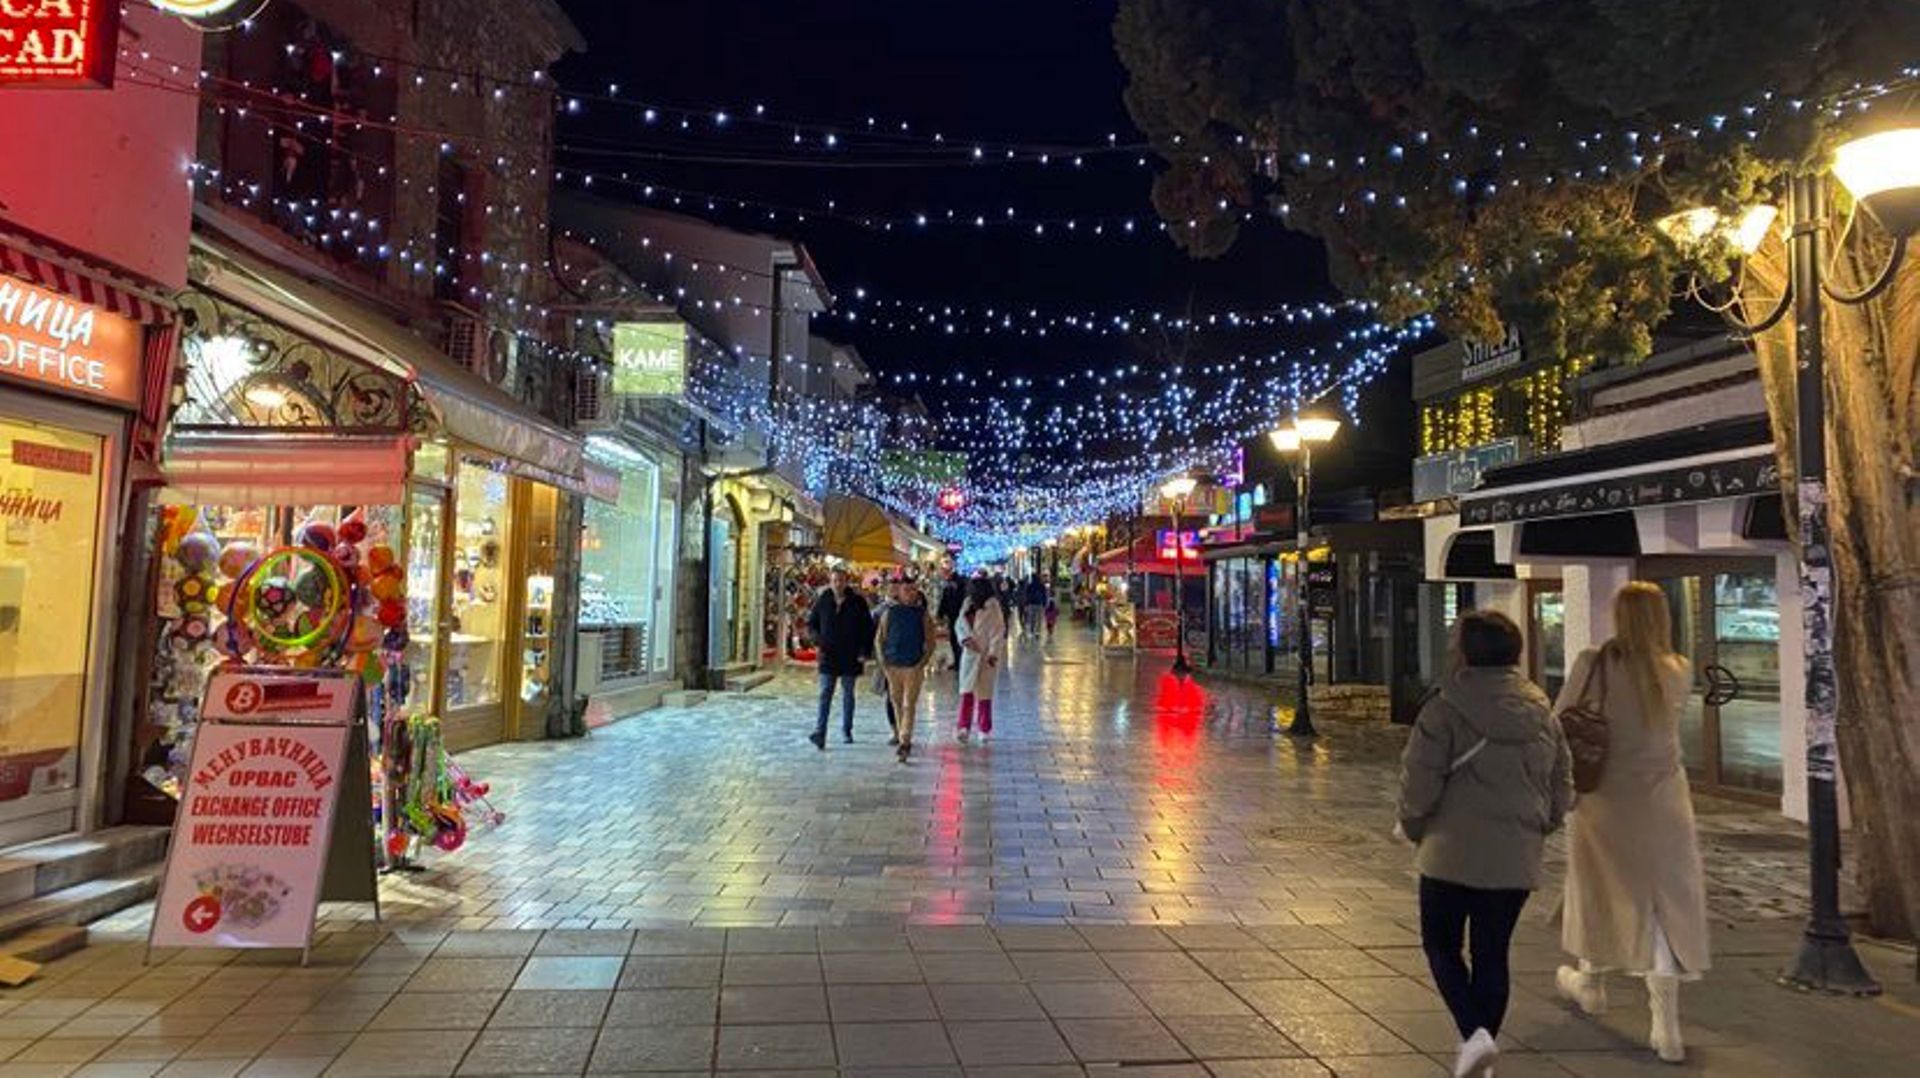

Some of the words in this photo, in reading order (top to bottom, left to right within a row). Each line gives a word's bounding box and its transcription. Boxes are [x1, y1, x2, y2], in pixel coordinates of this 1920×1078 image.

[0, 334, 105, 390] OFFICE
[620, 348, 679, 371] KAME
[194, 737, 332, 790] МЕНУВАЧНИЦА
[191, 796, 269, 817] EXCHANGE
[272, 797, 322, 818] OFFICE
[192, 824, 312, 846] WECHSELSTUBE
